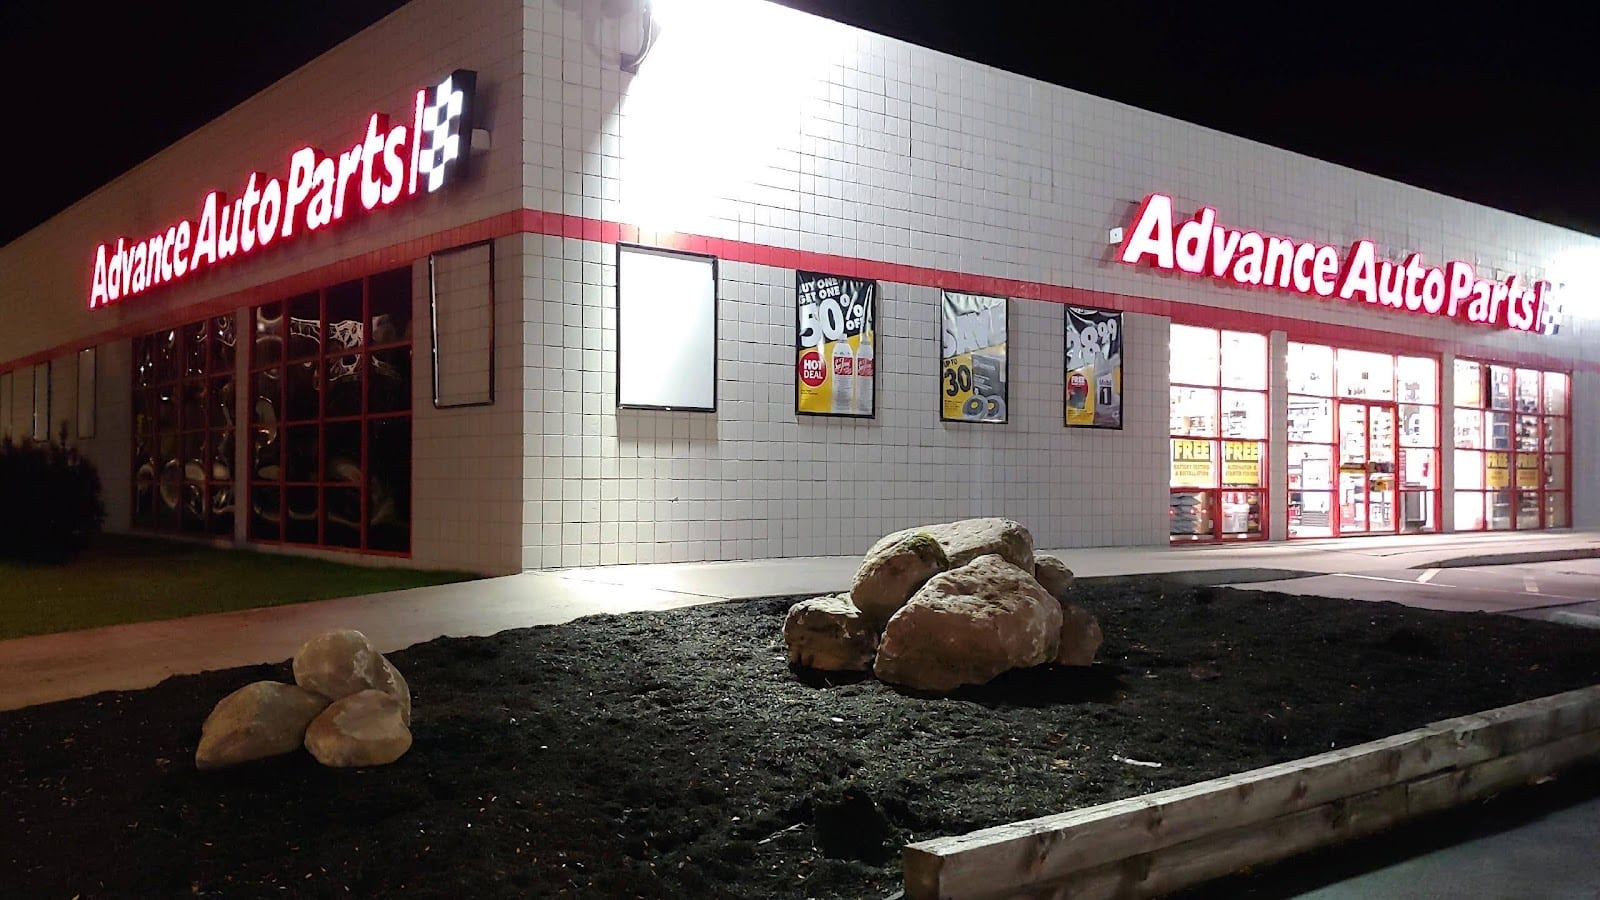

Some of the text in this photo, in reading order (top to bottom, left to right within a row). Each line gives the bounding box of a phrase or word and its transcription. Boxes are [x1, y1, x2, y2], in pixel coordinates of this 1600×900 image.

[90, 113, 407, 308] Advance Auto Parts
[1122, 193, 1537, 331] Advance Auto Parts
[799, 278, 838, 293] UY ONE
[799, 286, 840, 304] GET ONE
[803, 359, 824, 370] HOT
[803, 370, 823, 379] DEAL
[944, 364, 972, 397] 30
[1174, 440, 1210, 459] FREE
[1226, 441, 1258, 460] FREE
